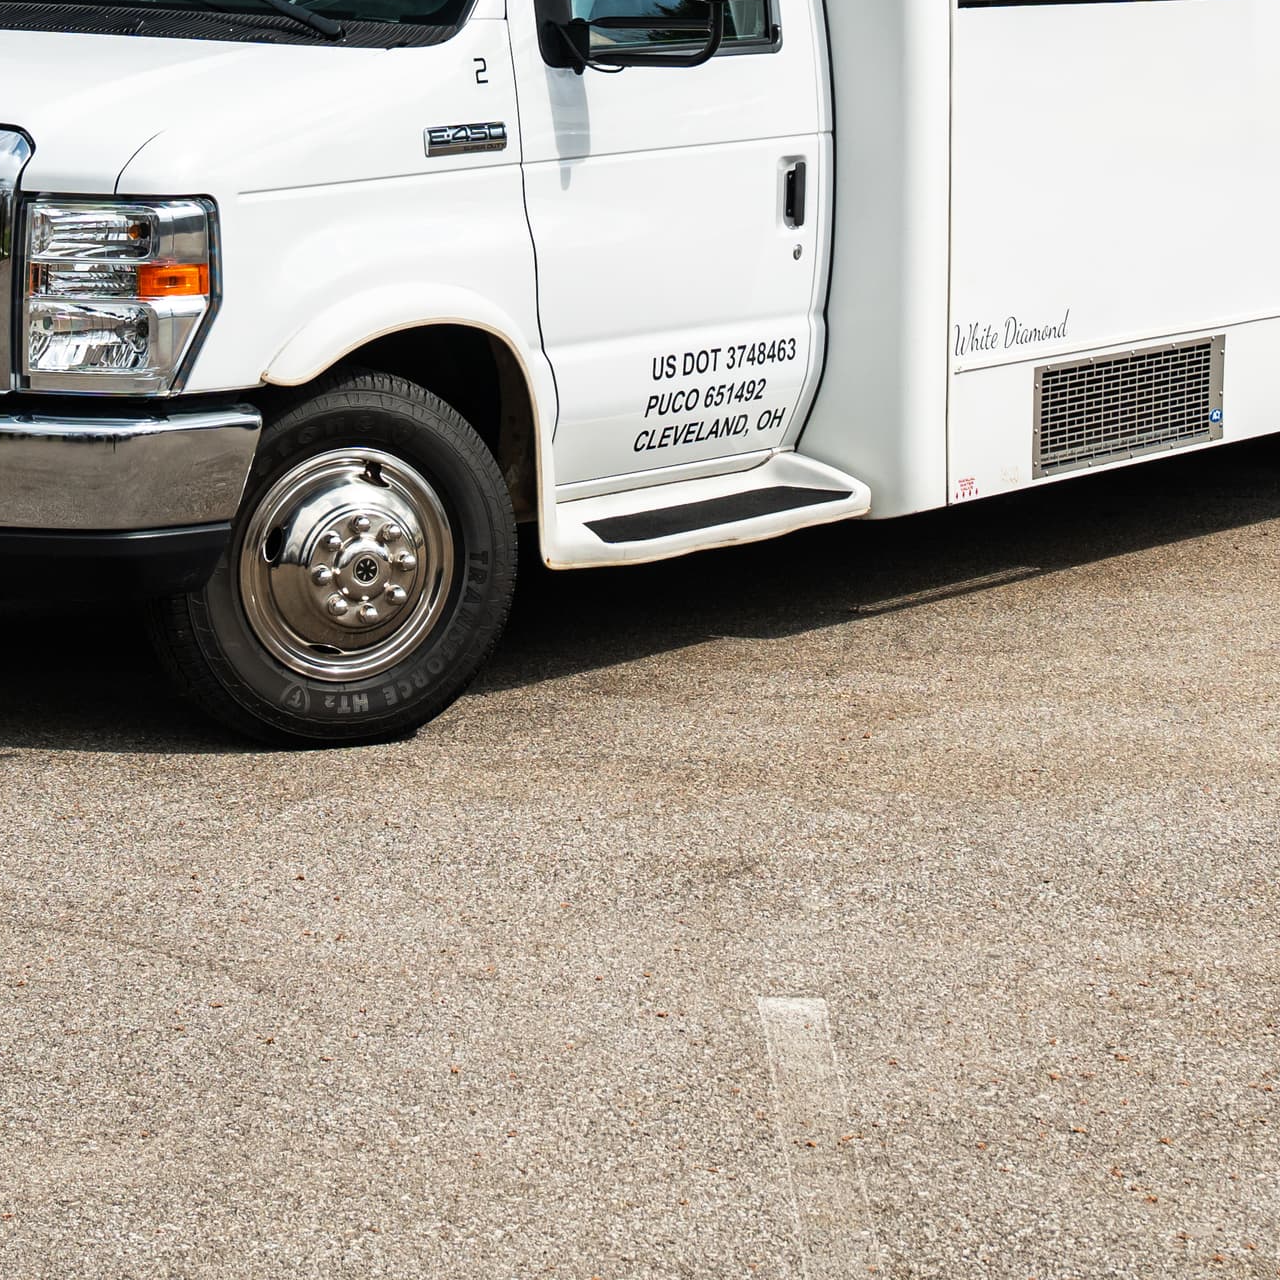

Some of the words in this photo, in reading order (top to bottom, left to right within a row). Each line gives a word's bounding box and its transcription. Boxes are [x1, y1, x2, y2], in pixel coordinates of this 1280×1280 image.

[472, 57, 489, 85] 2
[954, 320, 999, 357] White
[1003, 307, 1070, 349] Diamond
[652, 354, 677, 381] US
[683, 347, 722, 377] DOT
[726, 337, 796, 370] 3748463
[644, 387, 700, 418] PUCO
[704, 378, 767, 409] 651492
[633, 413, 749, 452] CLEVELAND,
[756, 407, 786, 432] OH
